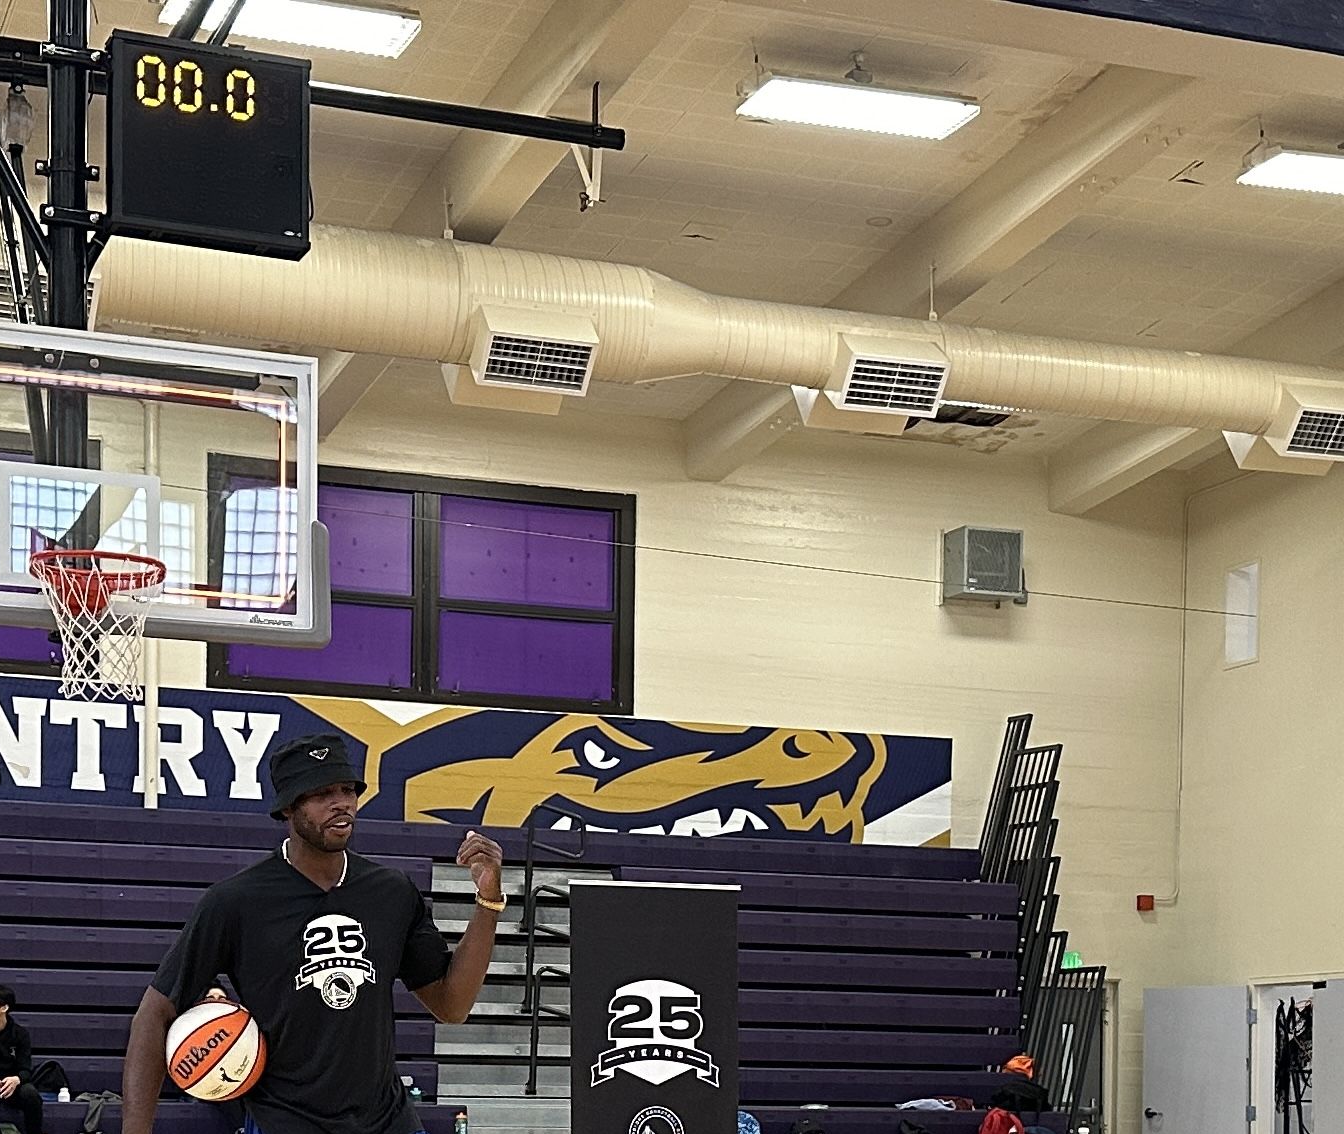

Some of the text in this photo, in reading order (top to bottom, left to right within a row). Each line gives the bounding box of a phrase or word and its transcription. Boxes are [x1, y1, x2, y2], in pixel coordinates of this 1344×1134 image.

[136, 54, 255, 121] 00.0
[305, 924, 365, 957] 25
[608, 993, 704, 1041] 25
[174, 1028, 231, 1080] Wilson
[628, 1048, 685, 1060] YEARS
